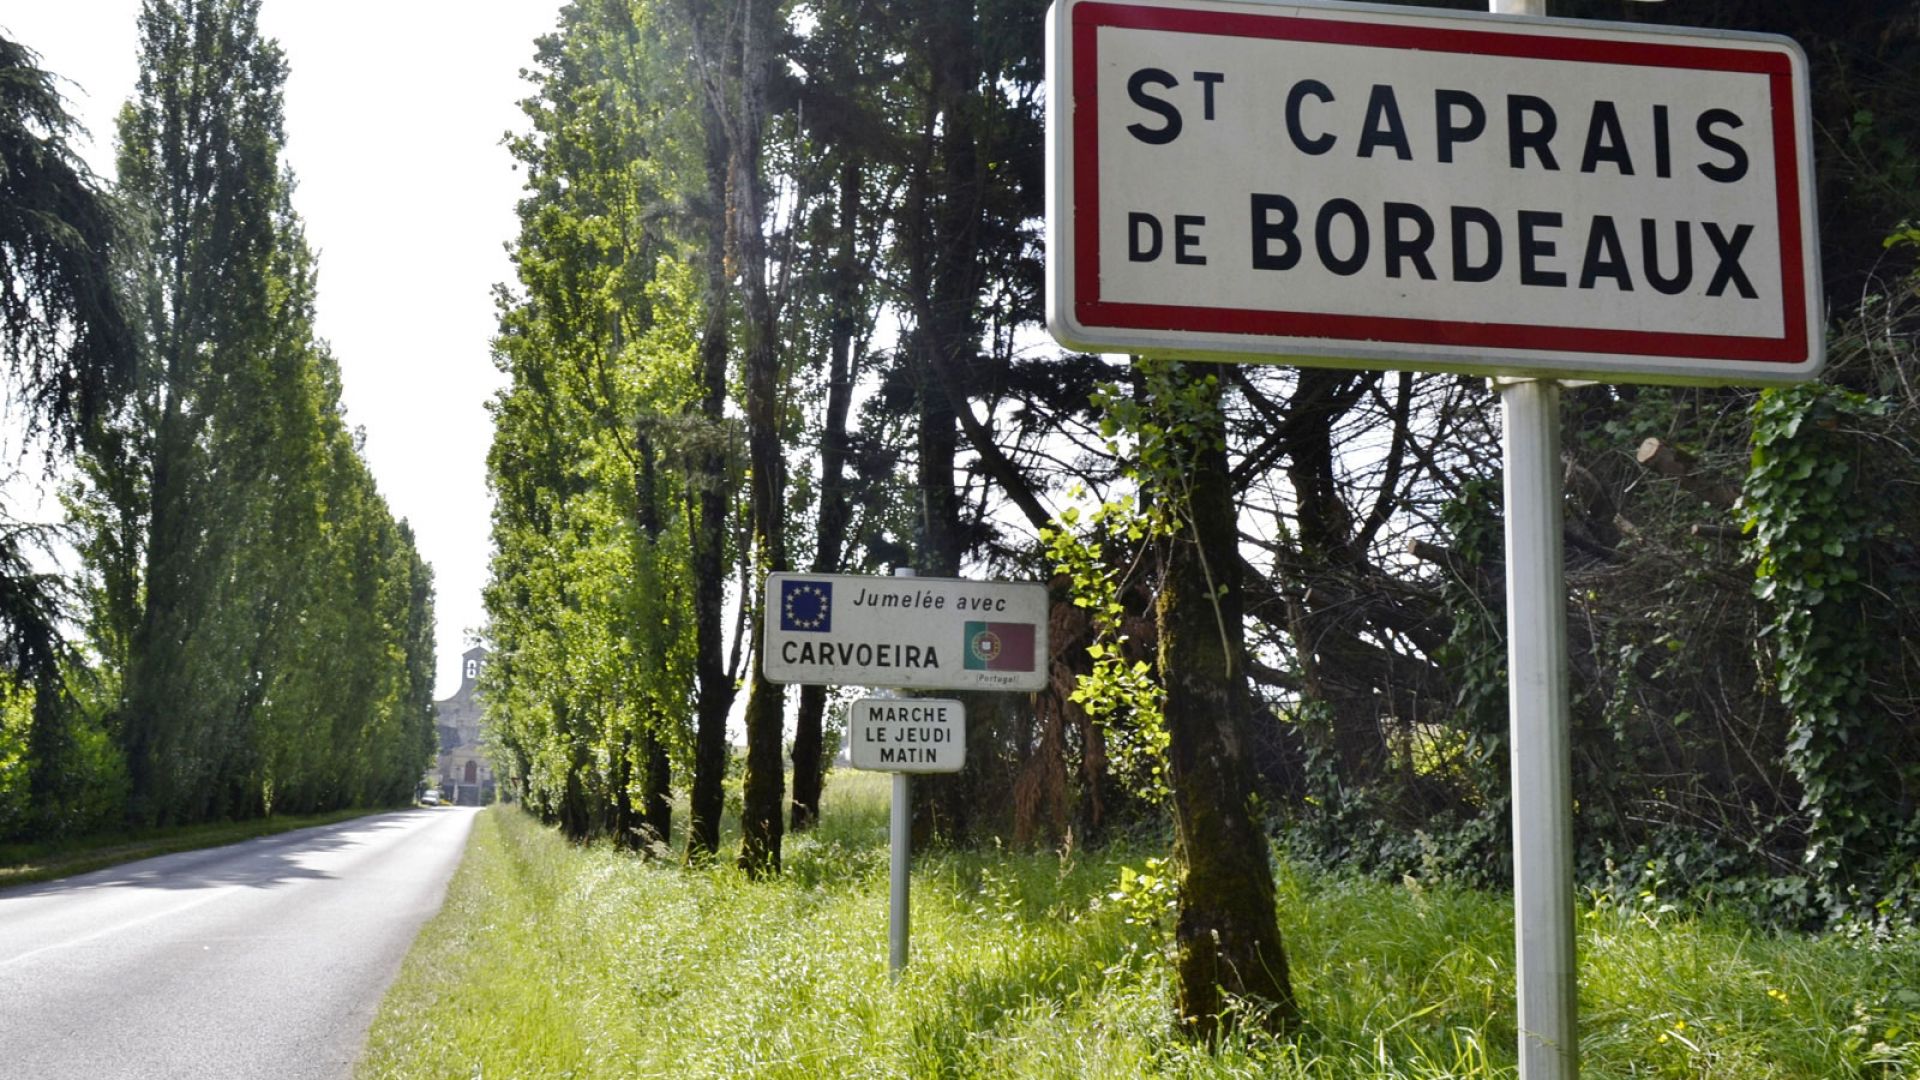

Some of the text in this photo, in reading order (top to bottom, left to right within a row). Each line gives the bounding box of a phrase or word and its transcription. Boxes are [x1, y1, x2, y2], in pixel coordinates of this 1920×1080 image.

[1284, 78, 1749, 184] CAPRAIS
[1128, 192, 1759, 299] DE BORDEAUX
[853, 588, 1007, 612] Jumelée avec
[782, 641, 939, 668] CARVOEIRA
[869, 707, 947, 722] MARCHE
[866, 727, 951, 743] LE JEUDI
[880, 748, 937, 763] MATIN
